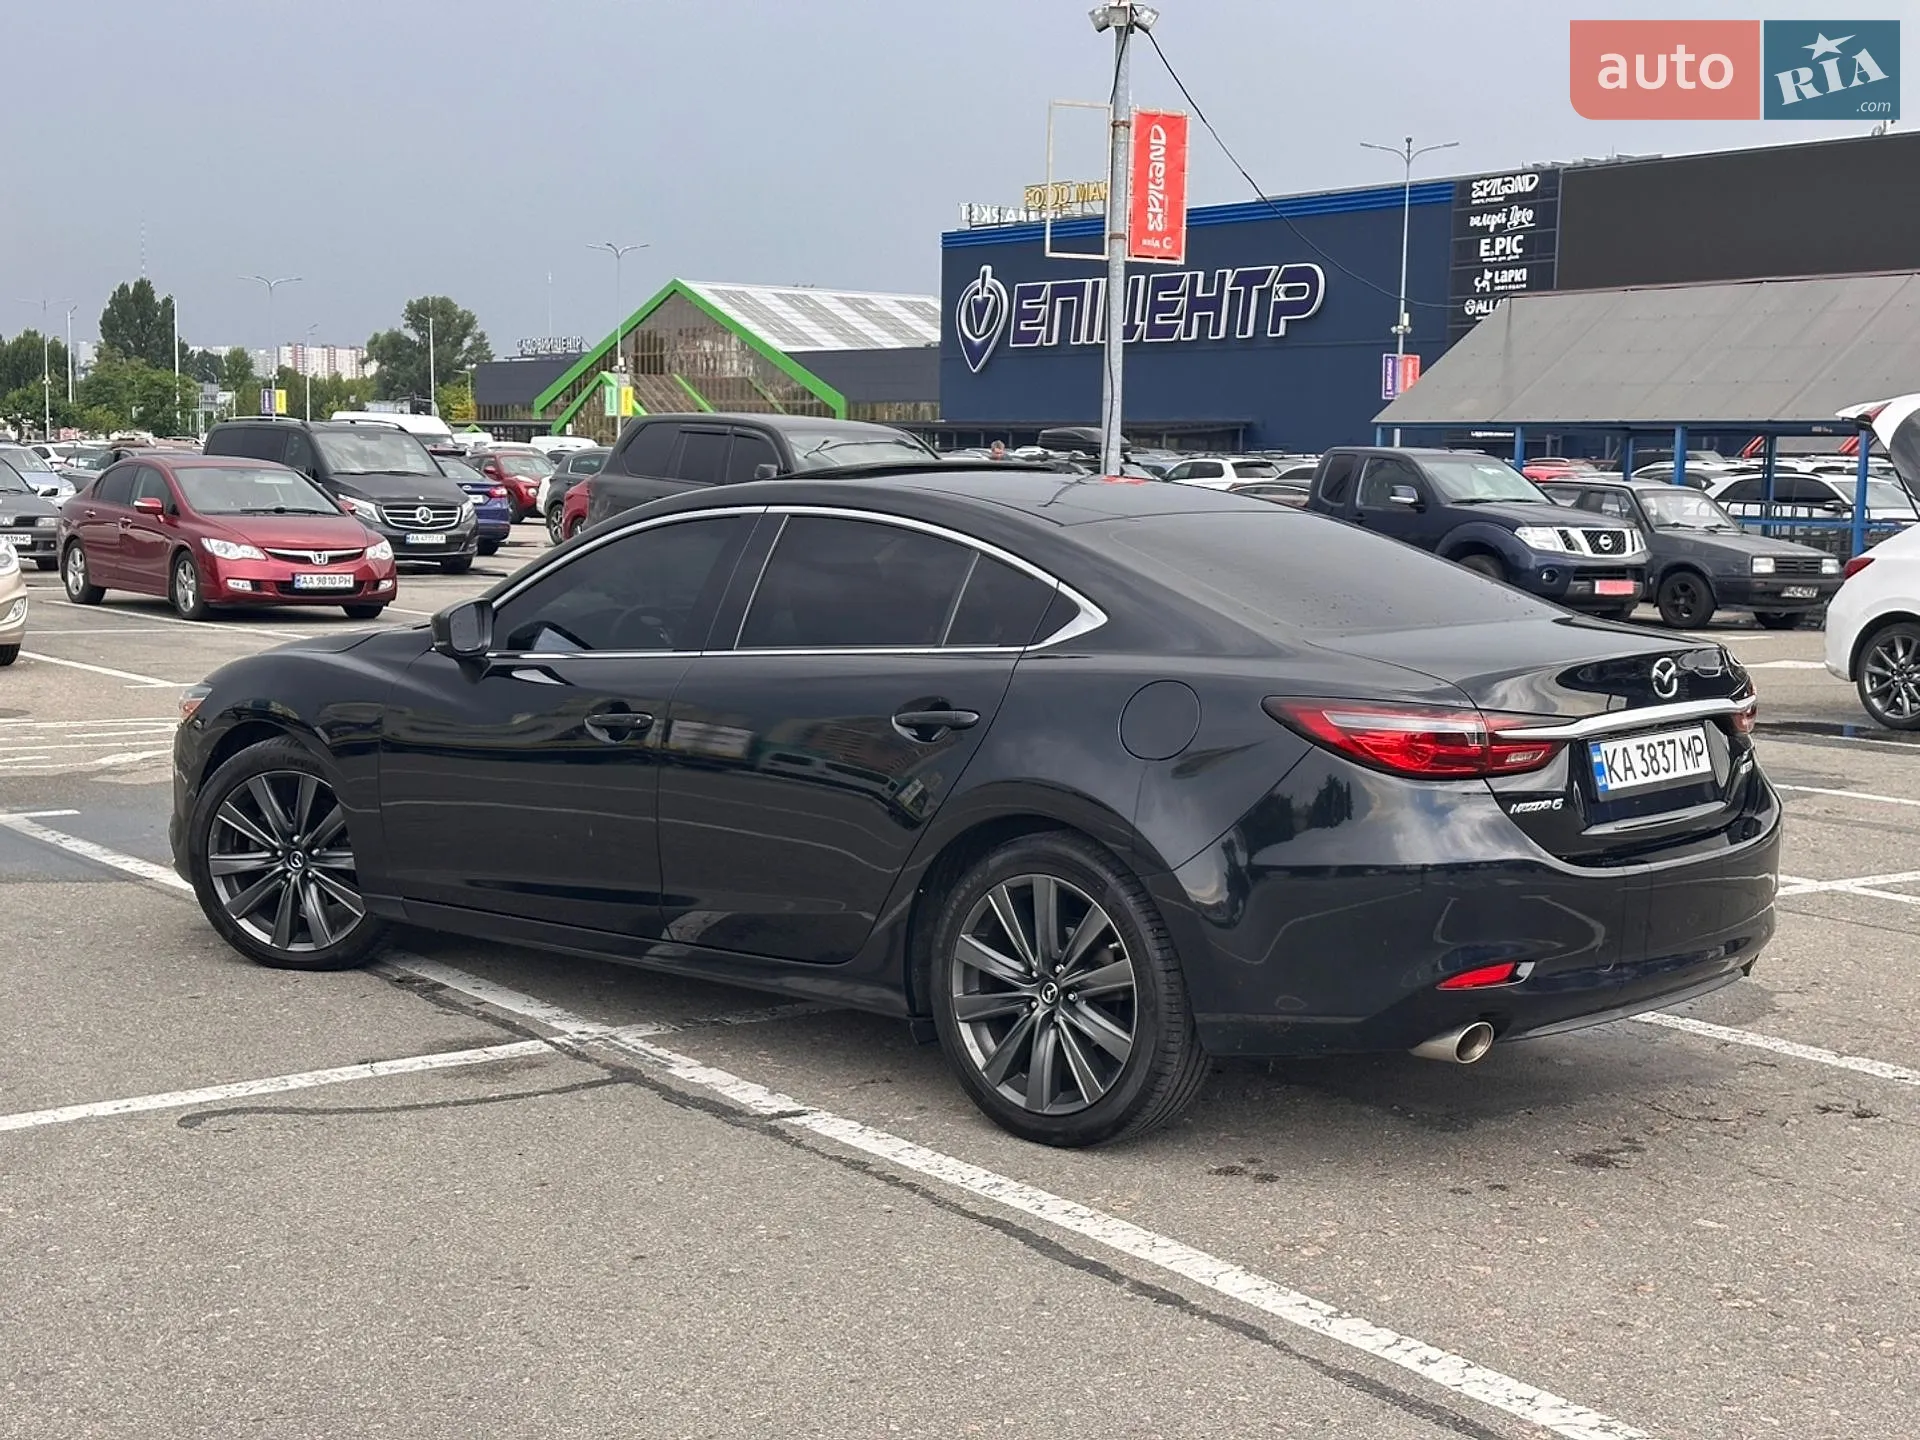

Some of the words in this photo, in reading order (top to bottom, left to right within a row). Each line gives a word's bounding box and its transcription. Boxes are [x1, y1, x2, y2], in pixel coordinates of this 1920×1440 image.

[1480, 235, 1524, 257] E.PIC
[1009, 263, 1326, 347] ЕПІЦЕНТР
[301, 575, 315, 586] AA
[338, 575, 352, 586] PH
[1604, 746, 1638, 784] KA
[1636, 738, 1677, 778] 3837
[1679, 734, 1704, 770] MP
